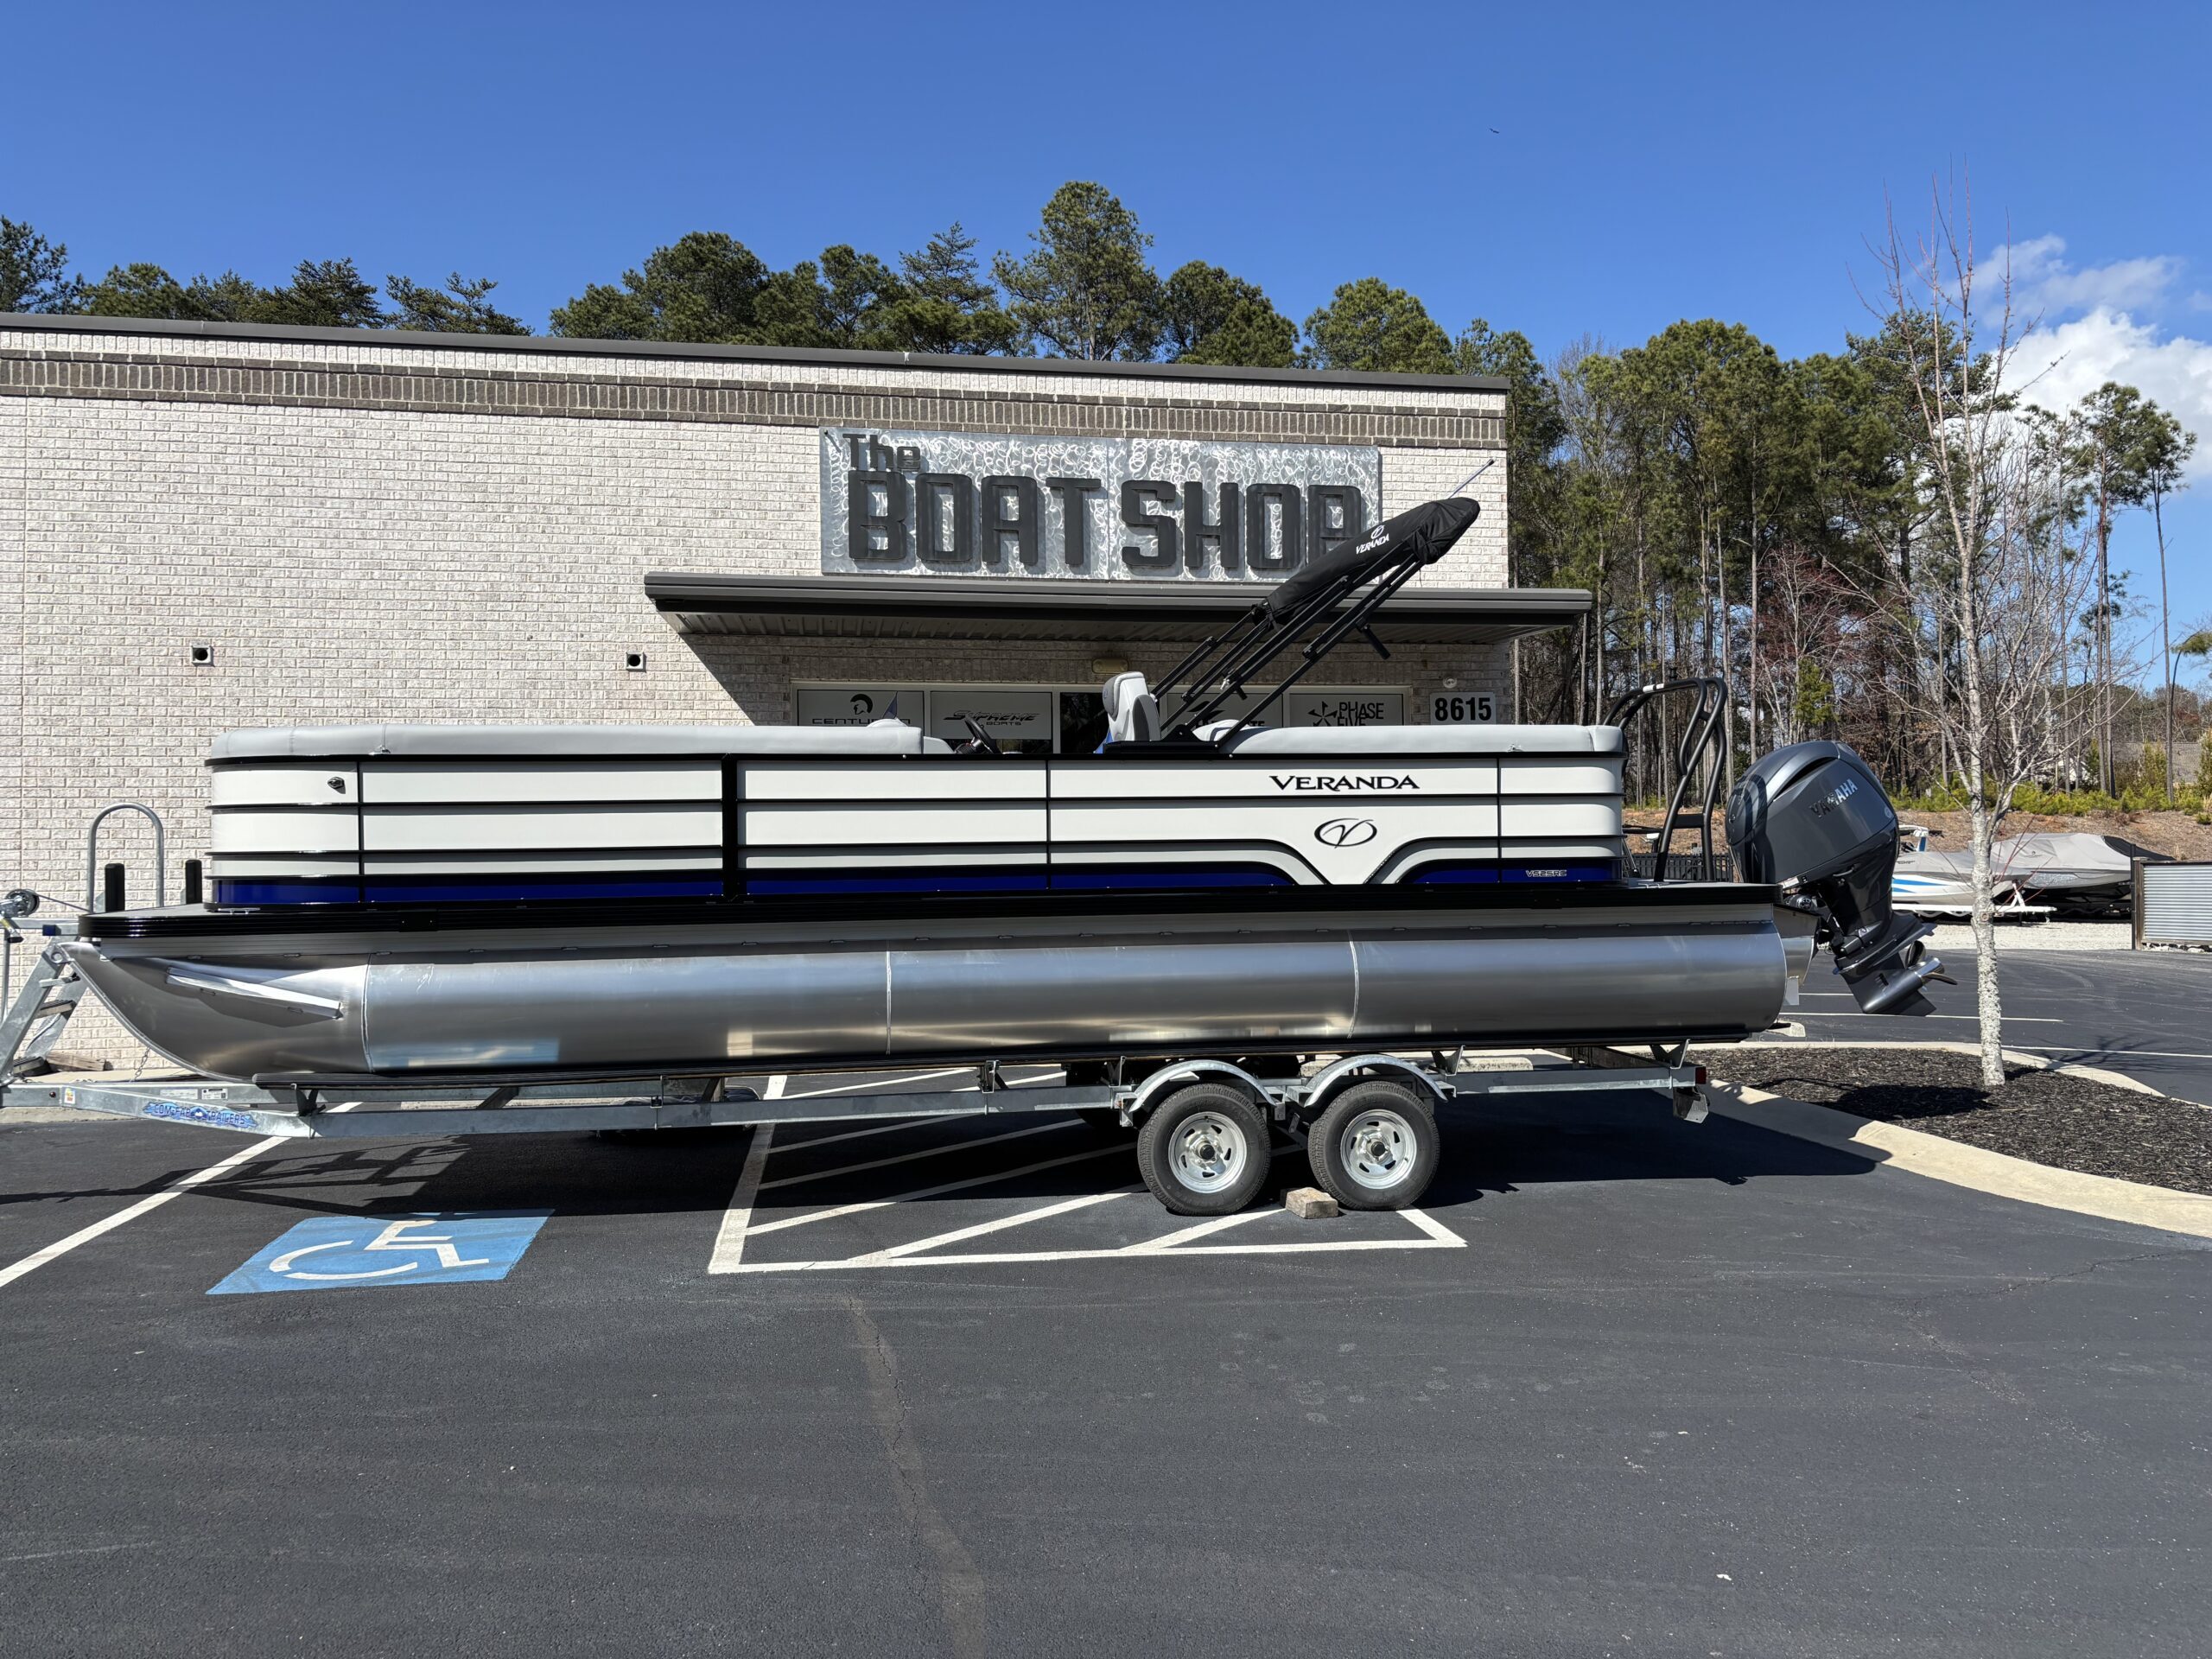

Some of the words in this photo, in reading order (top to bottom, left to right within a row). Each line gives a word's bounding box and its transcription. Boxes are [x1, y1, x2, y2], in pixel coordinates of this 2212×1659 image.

[842, 433, 921, 470] The
[848, 470, 1102, 565] BOAT
[1122, 480, 1362, 569] SHOP
[1356, 533, 1389, 555] VERANDA
[1338, 702, 1384, 720] PHASE
[1434, 696, 1492, 721] 8615
[1268, 774, 1421, 791] VERANDA
[206, 1110, 246, 1125] TRAILERS
